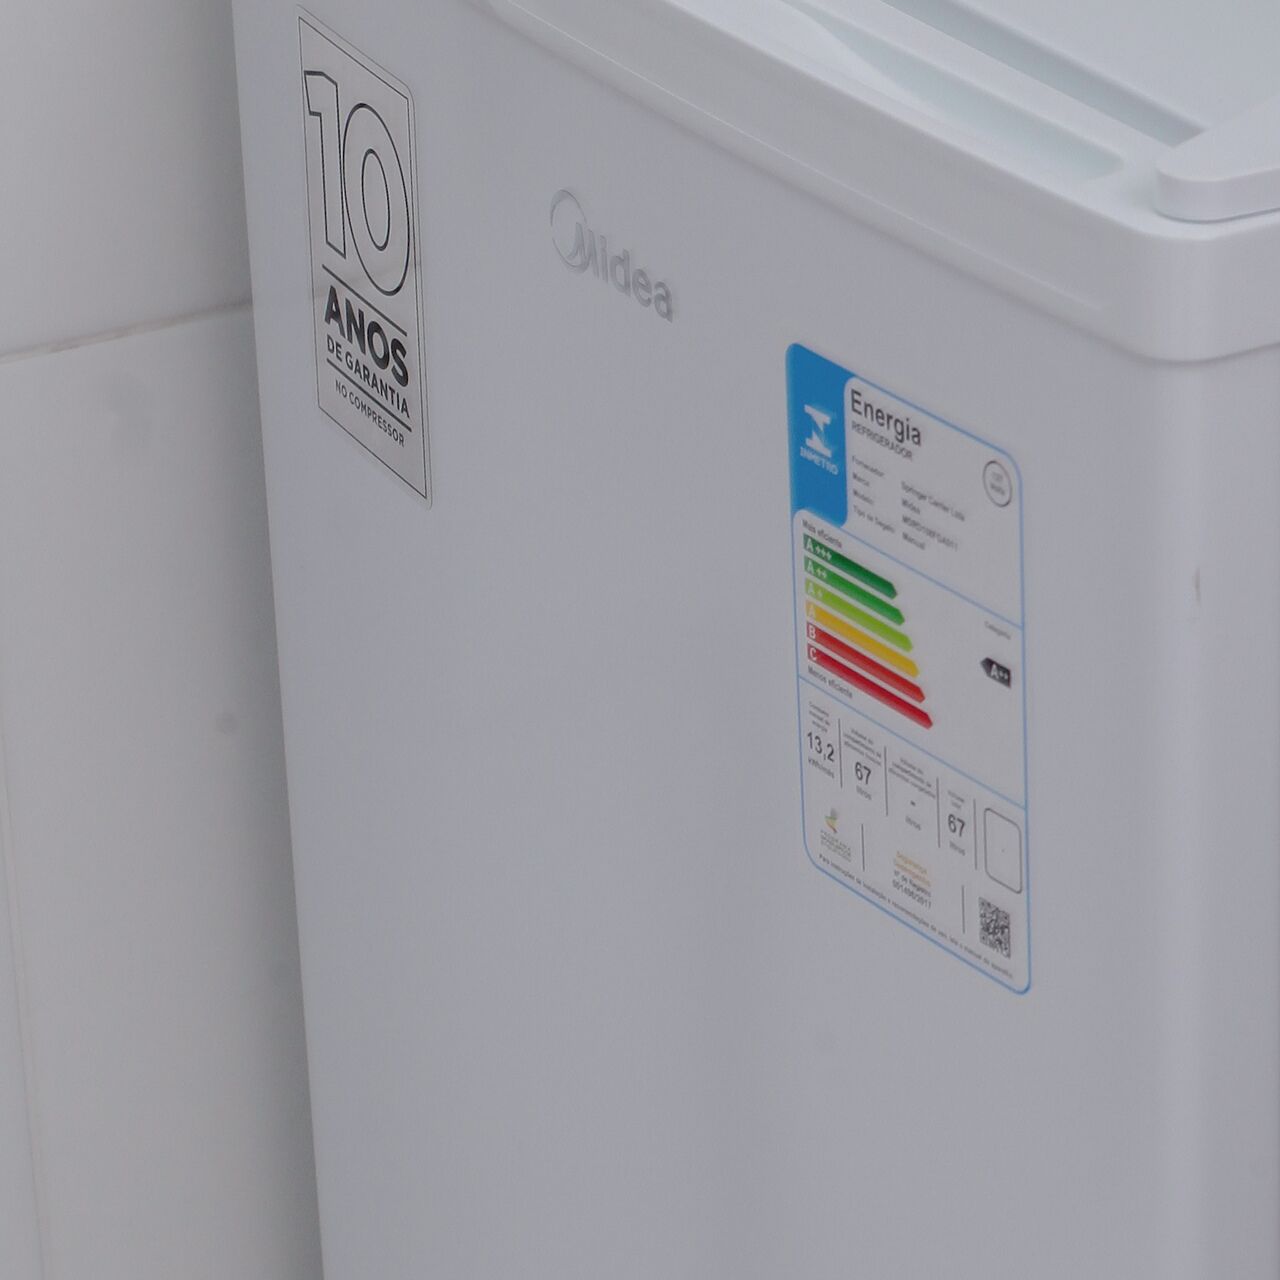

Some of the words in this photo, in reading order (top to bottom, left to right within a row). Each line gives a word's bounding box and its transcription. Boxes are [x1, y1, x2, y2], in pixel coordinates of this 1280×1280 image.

[303, 70, 410, 297] 10
[550, 189, 675, 323] Midea
[324, 284, 409, 388] ANOS
[326, 334, 342, 364] DE
[345, 349, 411, 419] GARANTIA
[335, 379, 348, 401] NO
[348, 390, 406, 448] COMPRESSOR
[850, 388, 921, 452] Energia
[851, 421, 912, 460] REFRIGERADOR
[808, 621, 816, 640] B
[809, 643, 818, 661] C
[807, 731, 836, 763] 13,2
[854, 760, 872, 785] 67
[947, 812, 966, 837] 67
